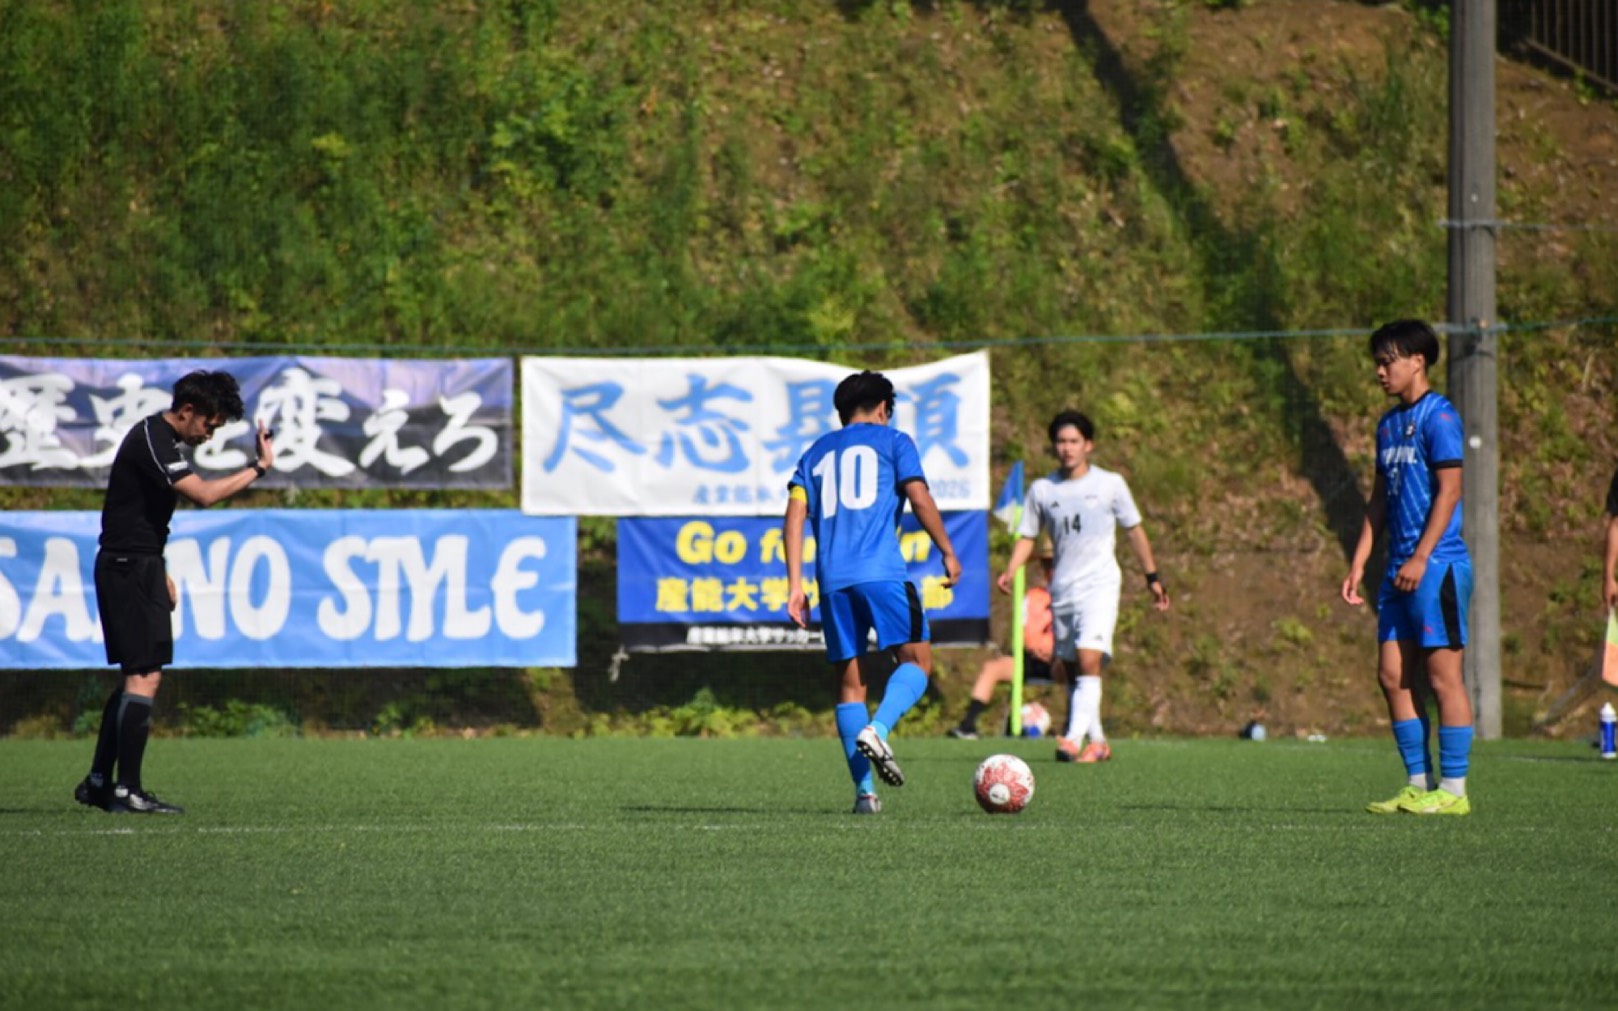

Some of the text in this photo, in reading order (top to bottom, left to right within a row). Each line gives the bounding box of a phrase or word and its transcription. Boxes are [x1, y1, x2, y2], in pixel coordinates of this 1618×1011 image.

[812, 444, 878, 518] 10
[676, 520, 747, 563] Go
[1063, 513, 1081, 535] 14
[0, 534, 546, 642] ANO STYLE
